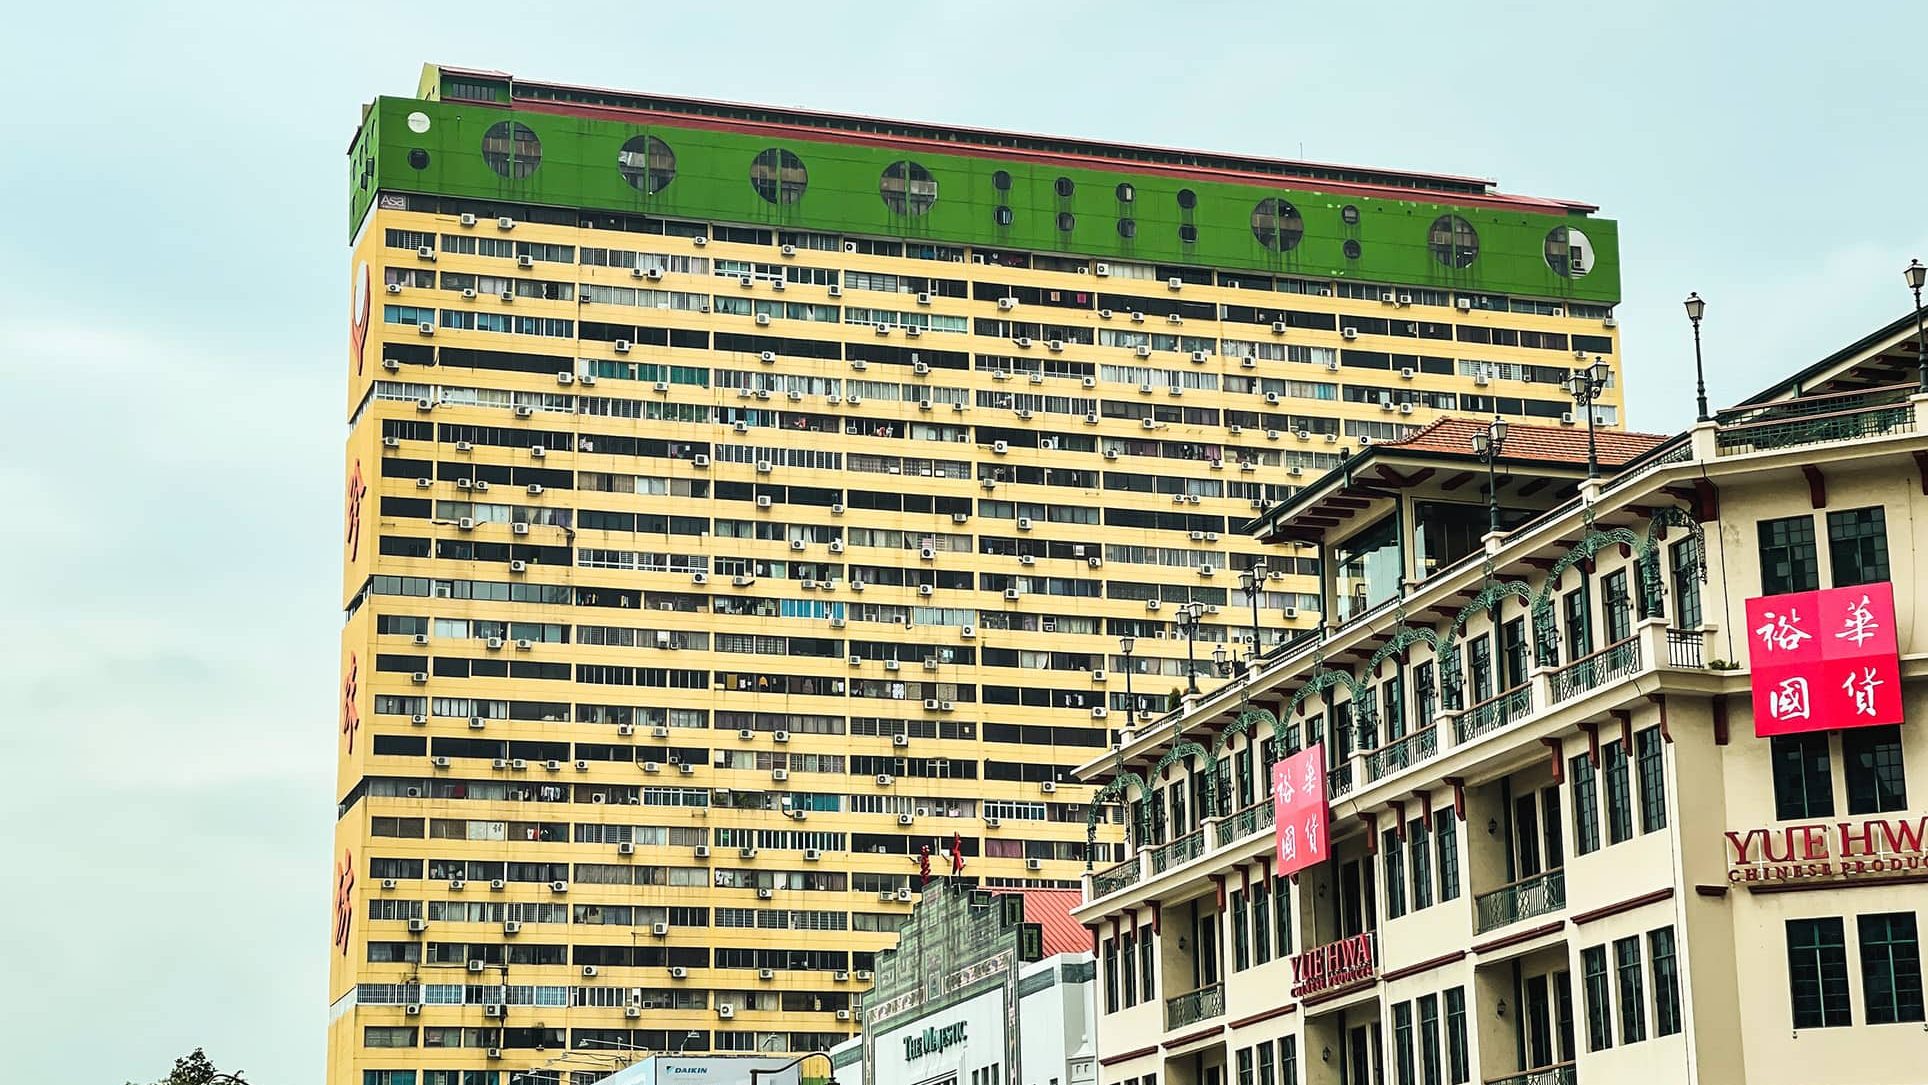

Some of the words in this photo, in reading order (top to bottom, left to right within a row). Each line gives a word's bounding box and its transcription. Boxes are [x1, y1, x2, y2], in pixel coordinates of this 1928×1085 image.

[1756, 595, 1879, 651] 裕華
[1770, 667, 1884, 721] 國貨
[1277, 753, 1316, 804] 裕華
[1281, 813, 1319, 862] 國貨
[1724, 824, 1829, 865] YUE
[1728, 863, 1832, 882] CHINESE
[1289, 947, 1323, 984] YUE
[1328, 933, 1371, 972] HWA
